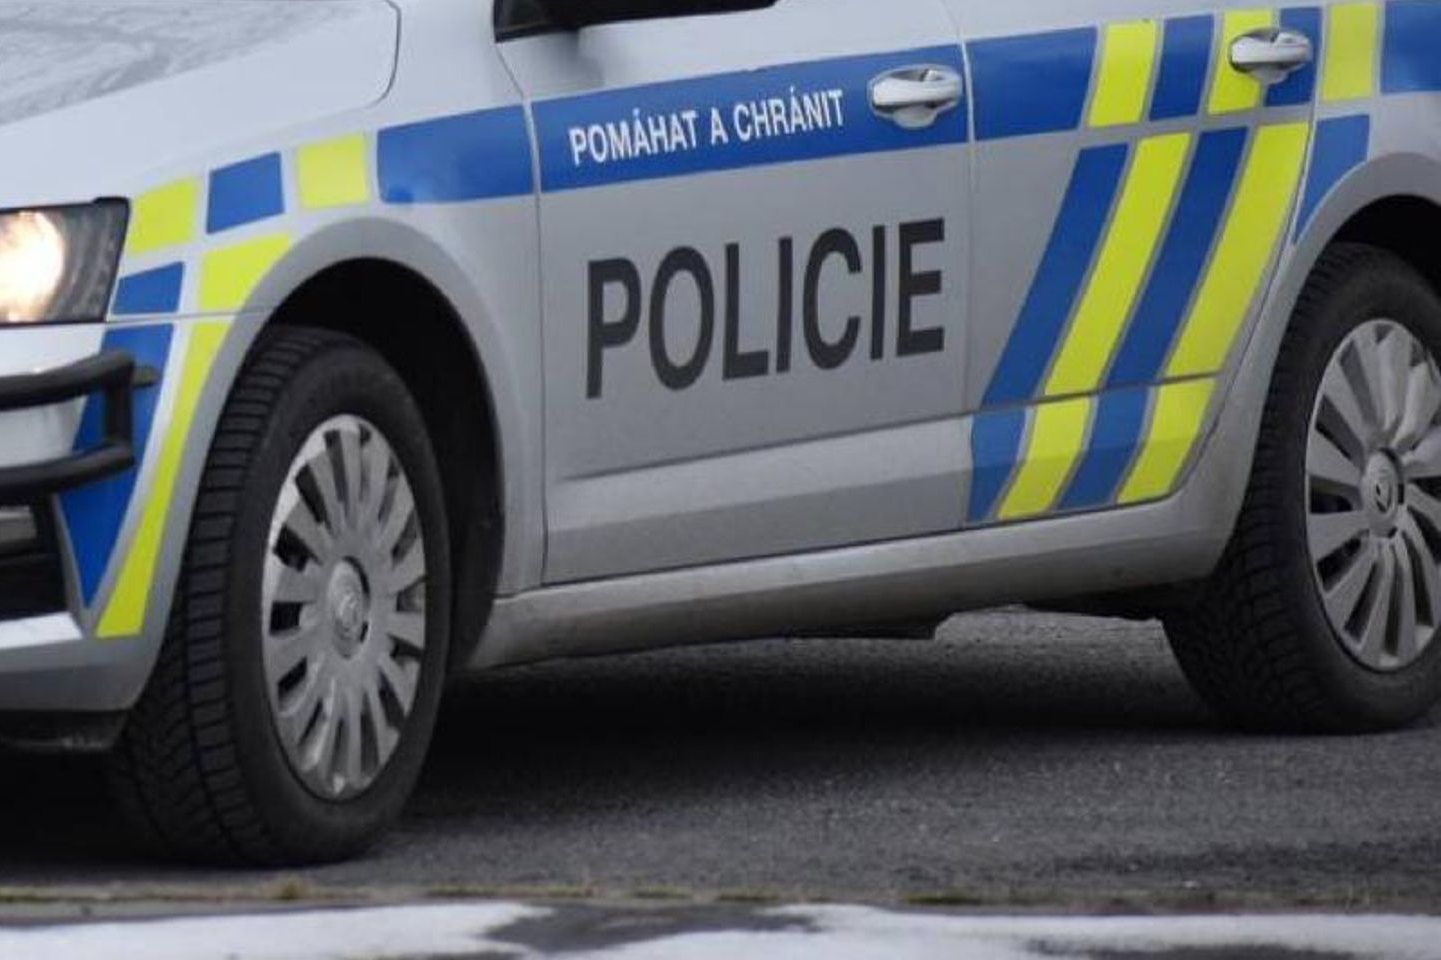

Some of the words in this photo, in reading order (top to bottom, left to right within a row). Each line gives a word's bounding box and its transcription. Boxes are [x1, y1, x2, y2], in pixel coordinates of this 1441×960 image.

[568, 107, 698, 167] POMÁHAT
[710, 107, 729, 146] A
[733, 86, 844, 141] CHRÁNIT
[585, 217, 945, 400] POLICIE
